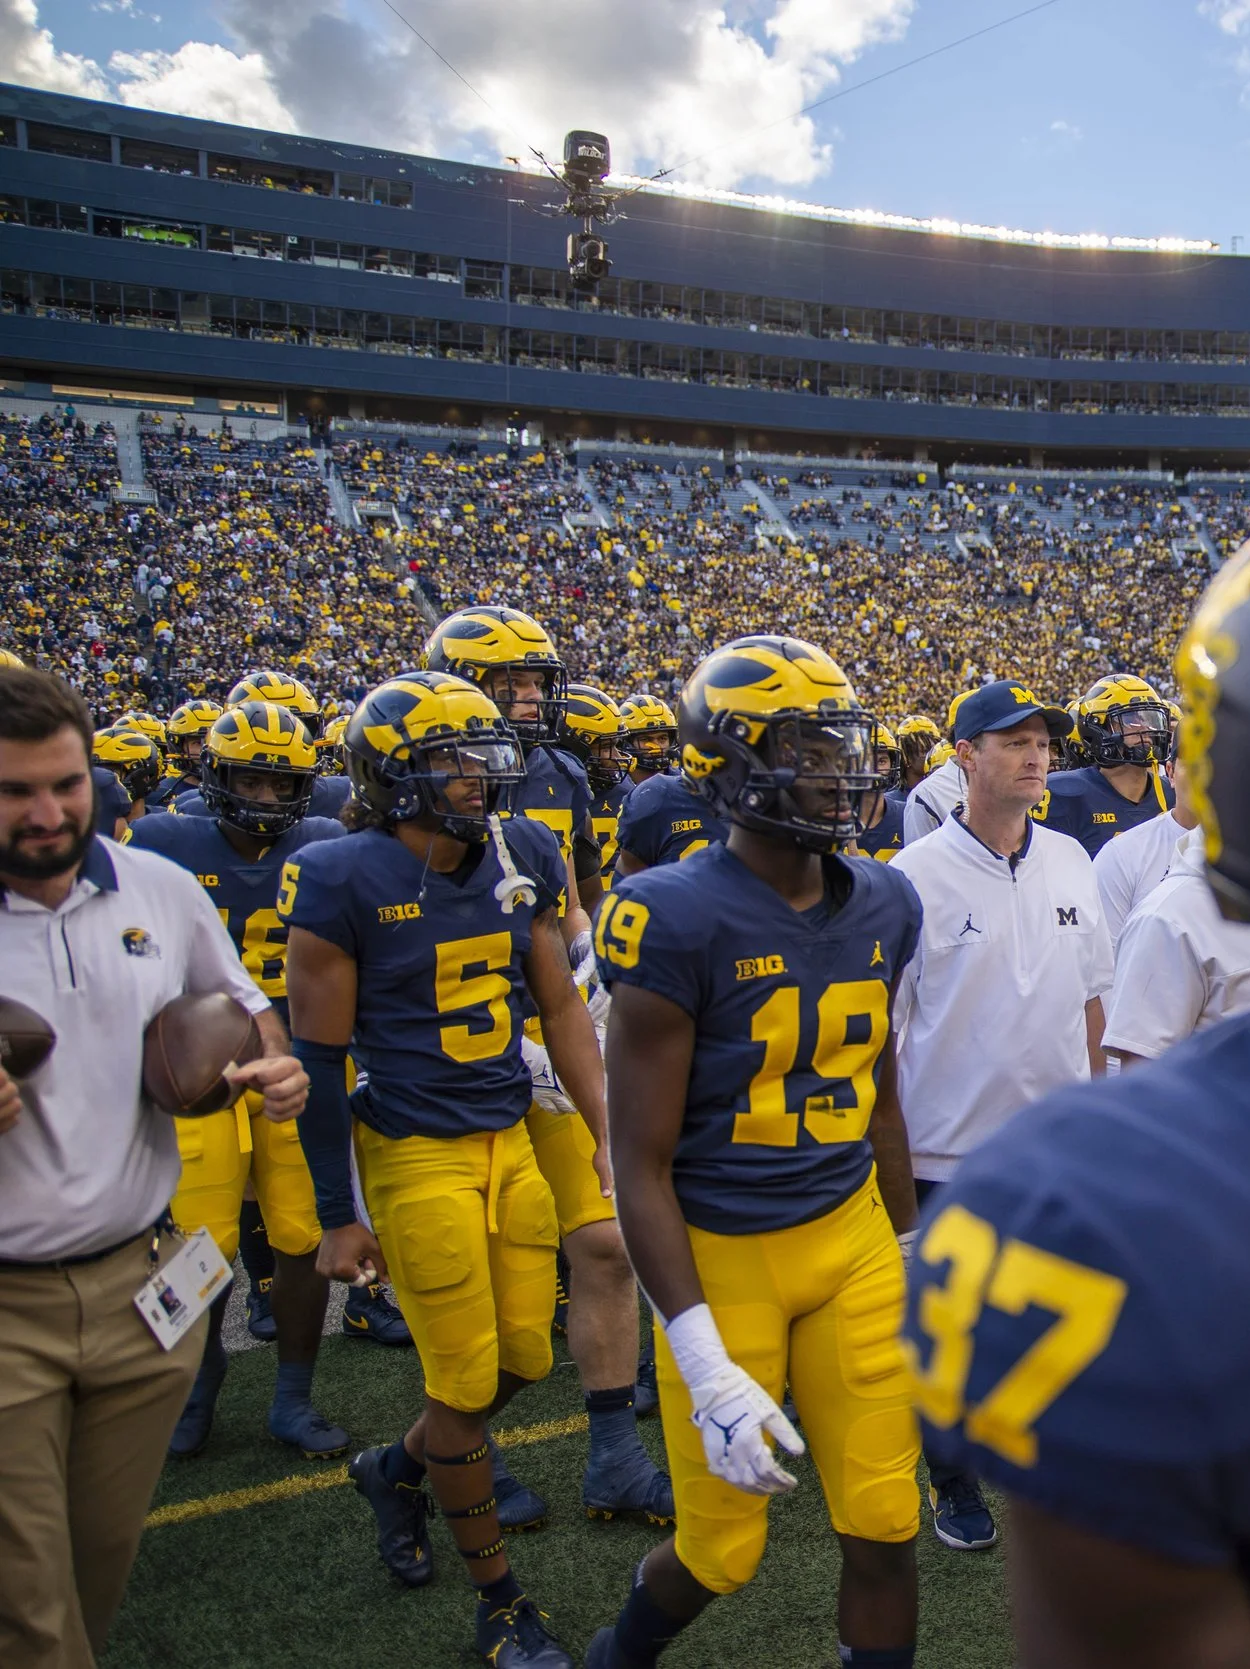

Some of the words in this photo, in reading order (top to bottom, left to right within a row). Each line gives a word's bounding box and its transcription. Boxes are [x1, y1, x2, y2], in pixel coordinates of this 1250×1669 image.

[1009, 687, 1045, 708] M
[266, 754, 279, 763] M
[276, 862, 301, 916] 5
[1056, 907, 1079, 926] M
[595, 893, 650, 970] 19
[435, 931, 512, 1063] 5
[731, 979, 889, 1148] 19
[903, 1205, 1130, 1468] 37
